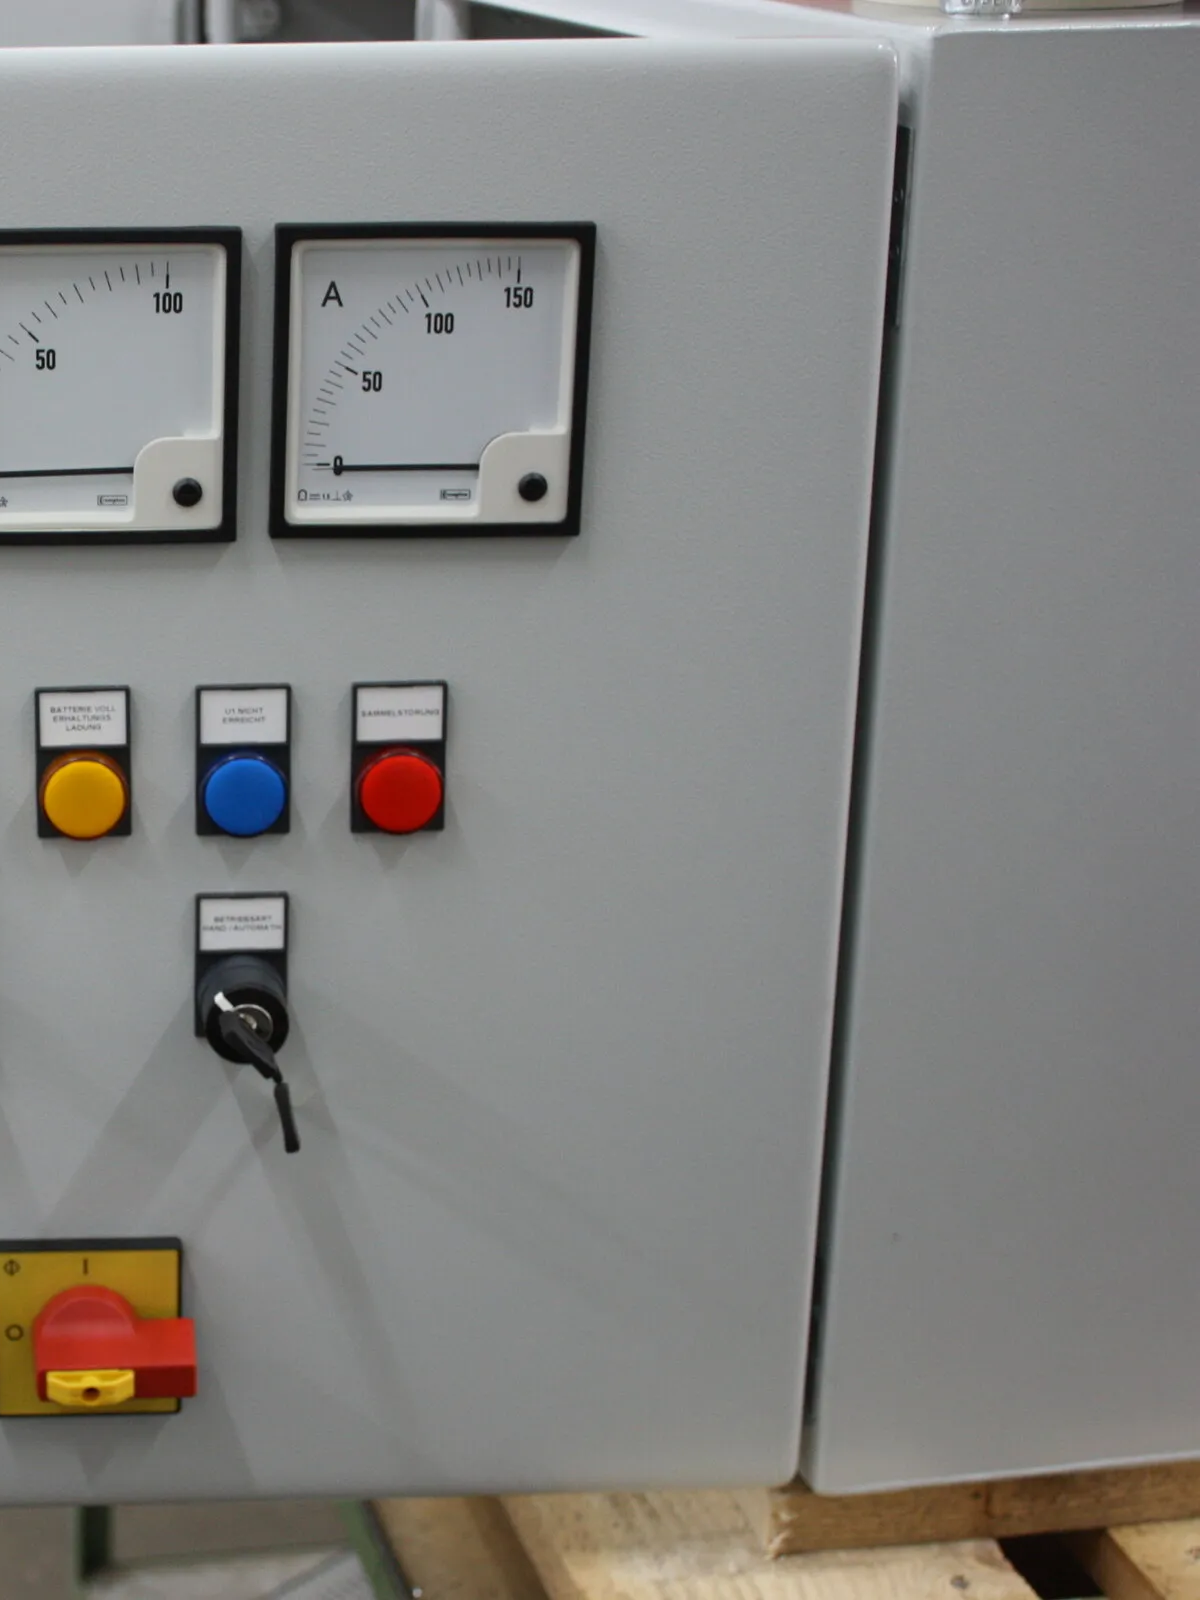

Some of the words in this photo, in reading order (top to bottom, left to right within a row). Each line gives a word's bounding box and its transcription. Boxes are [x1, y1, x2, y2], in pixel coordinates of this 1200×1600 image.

[153, 292, 183, 314] 100
[321, 280, 343, 307] A
[504, 286, 534, 308] 150
[424, 313, 454, 334] 100
[35, 349, 56, 370] 50
[361, 371, 383, 392] 50
[333, 455, 344, 476] 0
